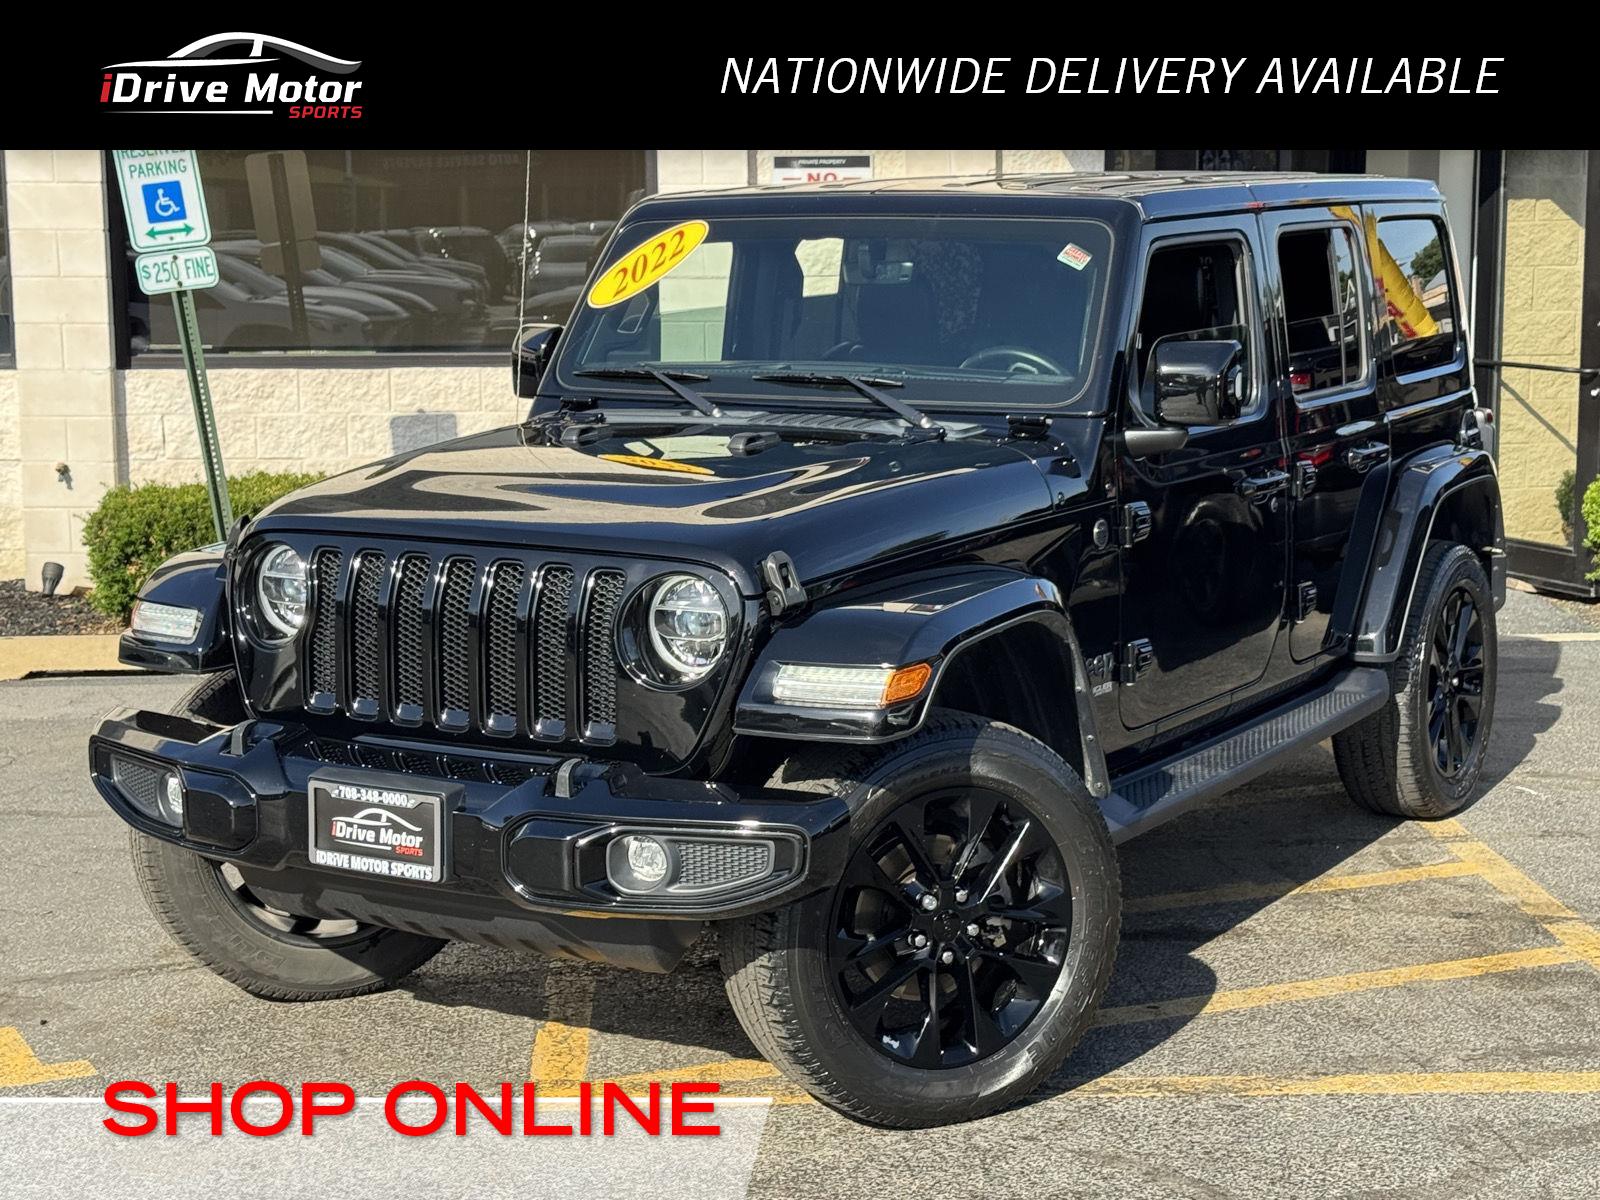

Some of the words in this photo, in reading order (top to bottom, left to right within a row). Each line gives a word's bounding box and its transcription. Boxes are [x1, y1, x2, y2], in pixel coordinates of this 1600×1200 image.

[128, 159, 187, 178] PARKING
[141, 260, 180, 283] $250
[184, 256, 214, 279] FINE
[613, 230, 685, 298] 2022
[338, 785, 408, 807] 708-348-0000
[331, 820, 376, 842] iDrive
[380, 828, 423, 849] Motor
[395, 845, 424, 857] SPORTS
[351, 856, 390, 875] MOTOR
[391, 862, 433, 880] SPORTS
